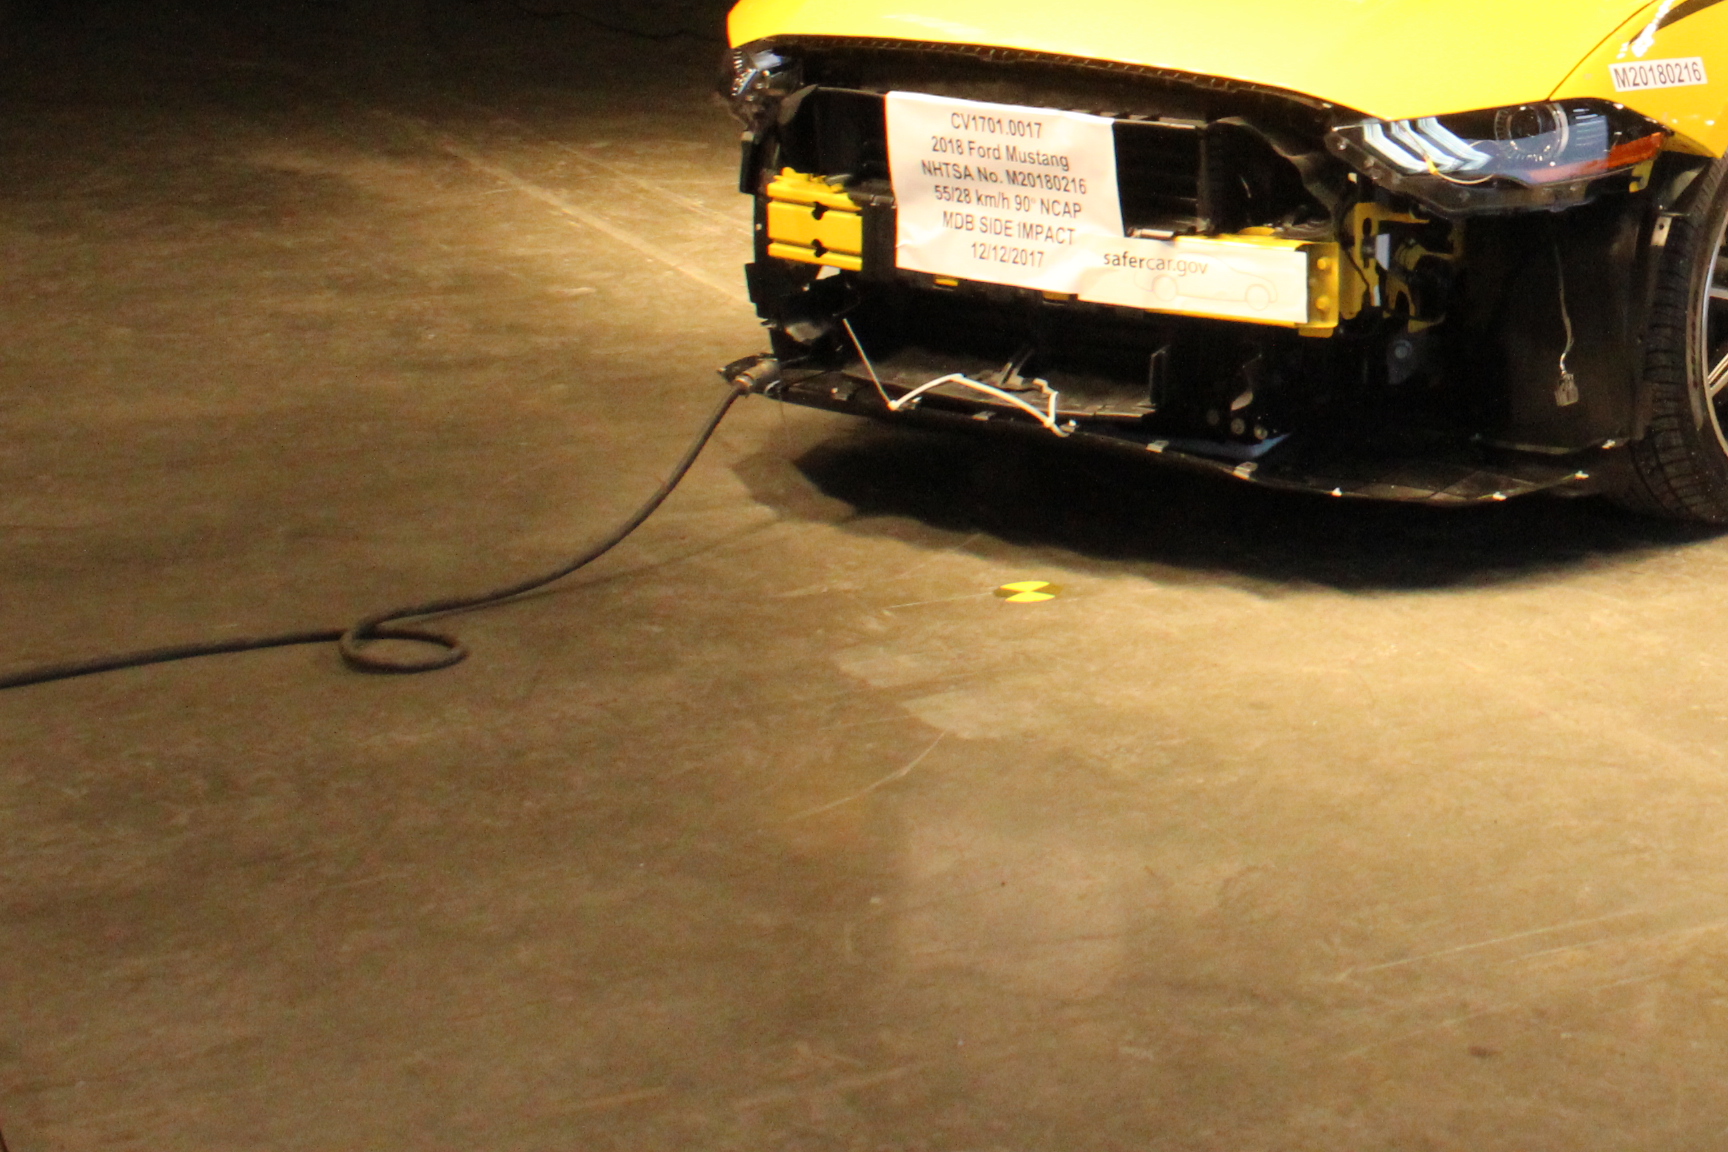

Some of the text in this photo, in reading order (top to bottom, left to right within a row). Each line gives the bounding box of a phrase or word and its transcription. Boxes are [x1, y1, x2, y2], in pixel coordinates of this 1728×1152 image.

[1613, 61, 1702, 89] M20180216
[950, 112, 1043, 139] CV1701.0017
[931, 135, 1070, 172] 2018 Ford Mustang
[921, 159, 1088, 195] NHTSA No. M20180216
[934, 184, 972, 205] 55/28
[975, 190, 1011, 210] km/h
[1040, 198, 1083, 220] NCAP
[942, 210, 1076, 245] MDB SIDE IMPACT
[971, 242, 1045, 268] 12/12/2017
[1103, 250, 1209, 277] safercar.gov
